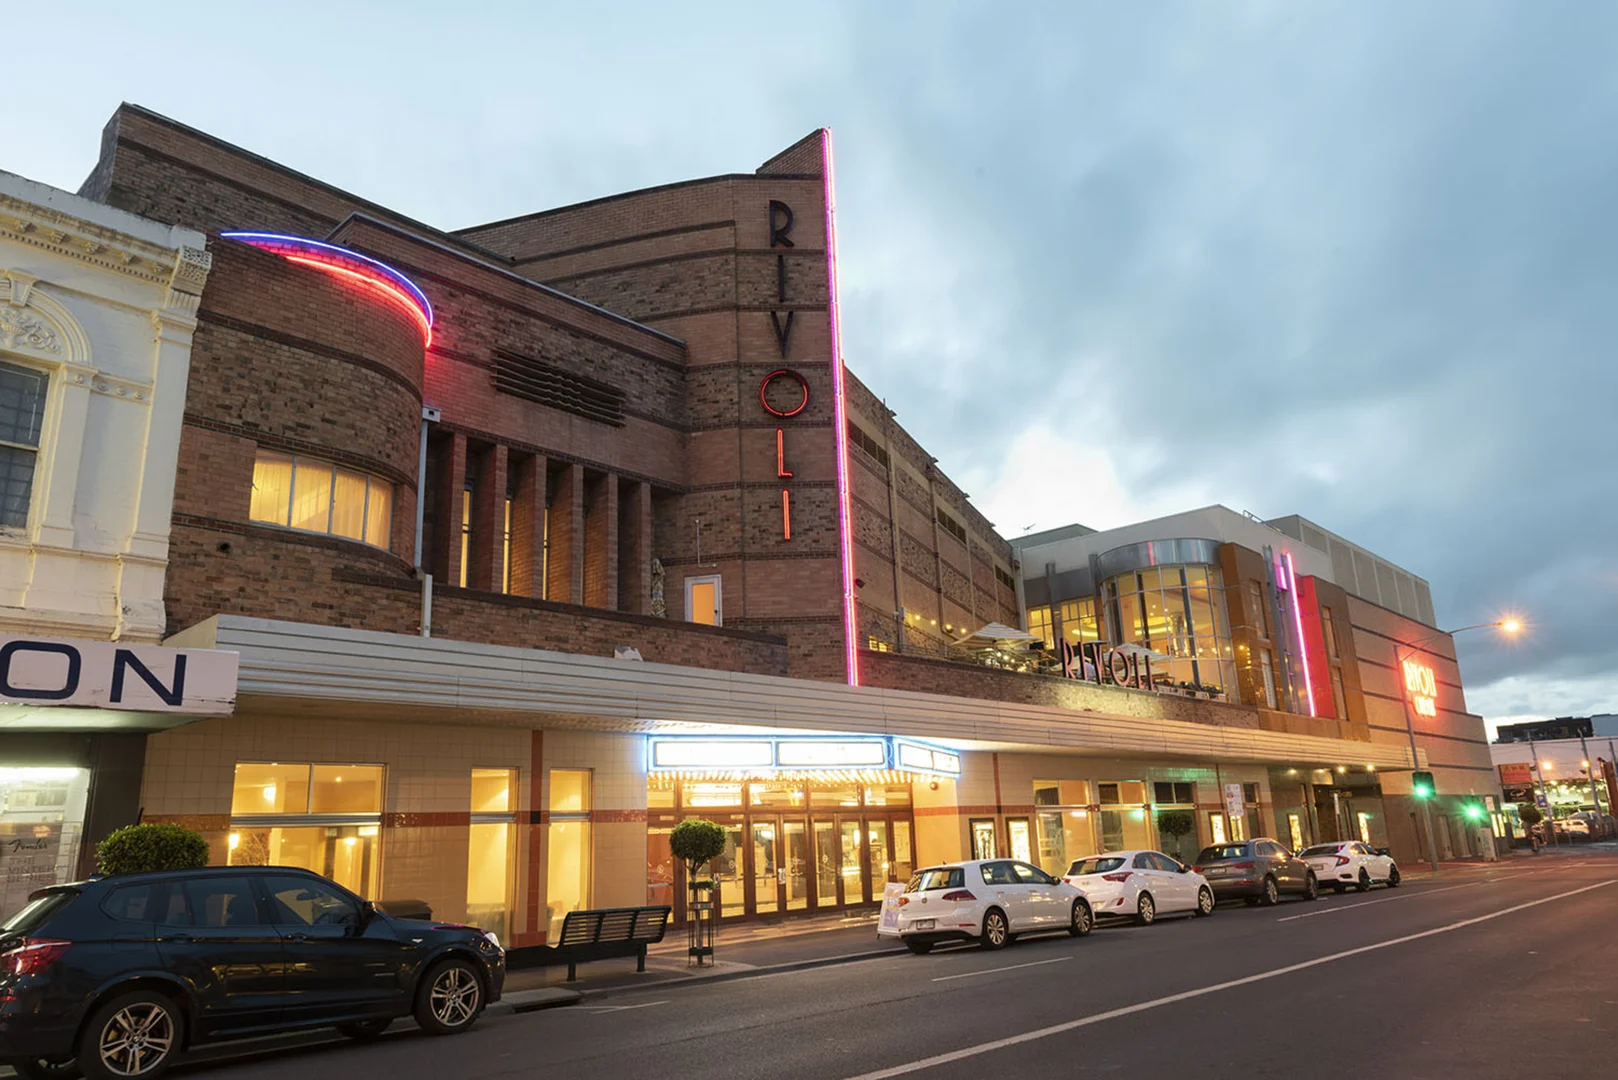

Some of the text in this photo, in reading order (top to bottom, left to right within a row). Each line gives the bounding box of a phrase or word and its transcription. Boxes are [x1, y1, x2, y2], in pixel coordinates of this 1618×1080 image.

[759, 200, 809, 540] RIVOLI
[0, 640, 187, 706] ON
[1060, 638, 1155, 692] RIVOLI
